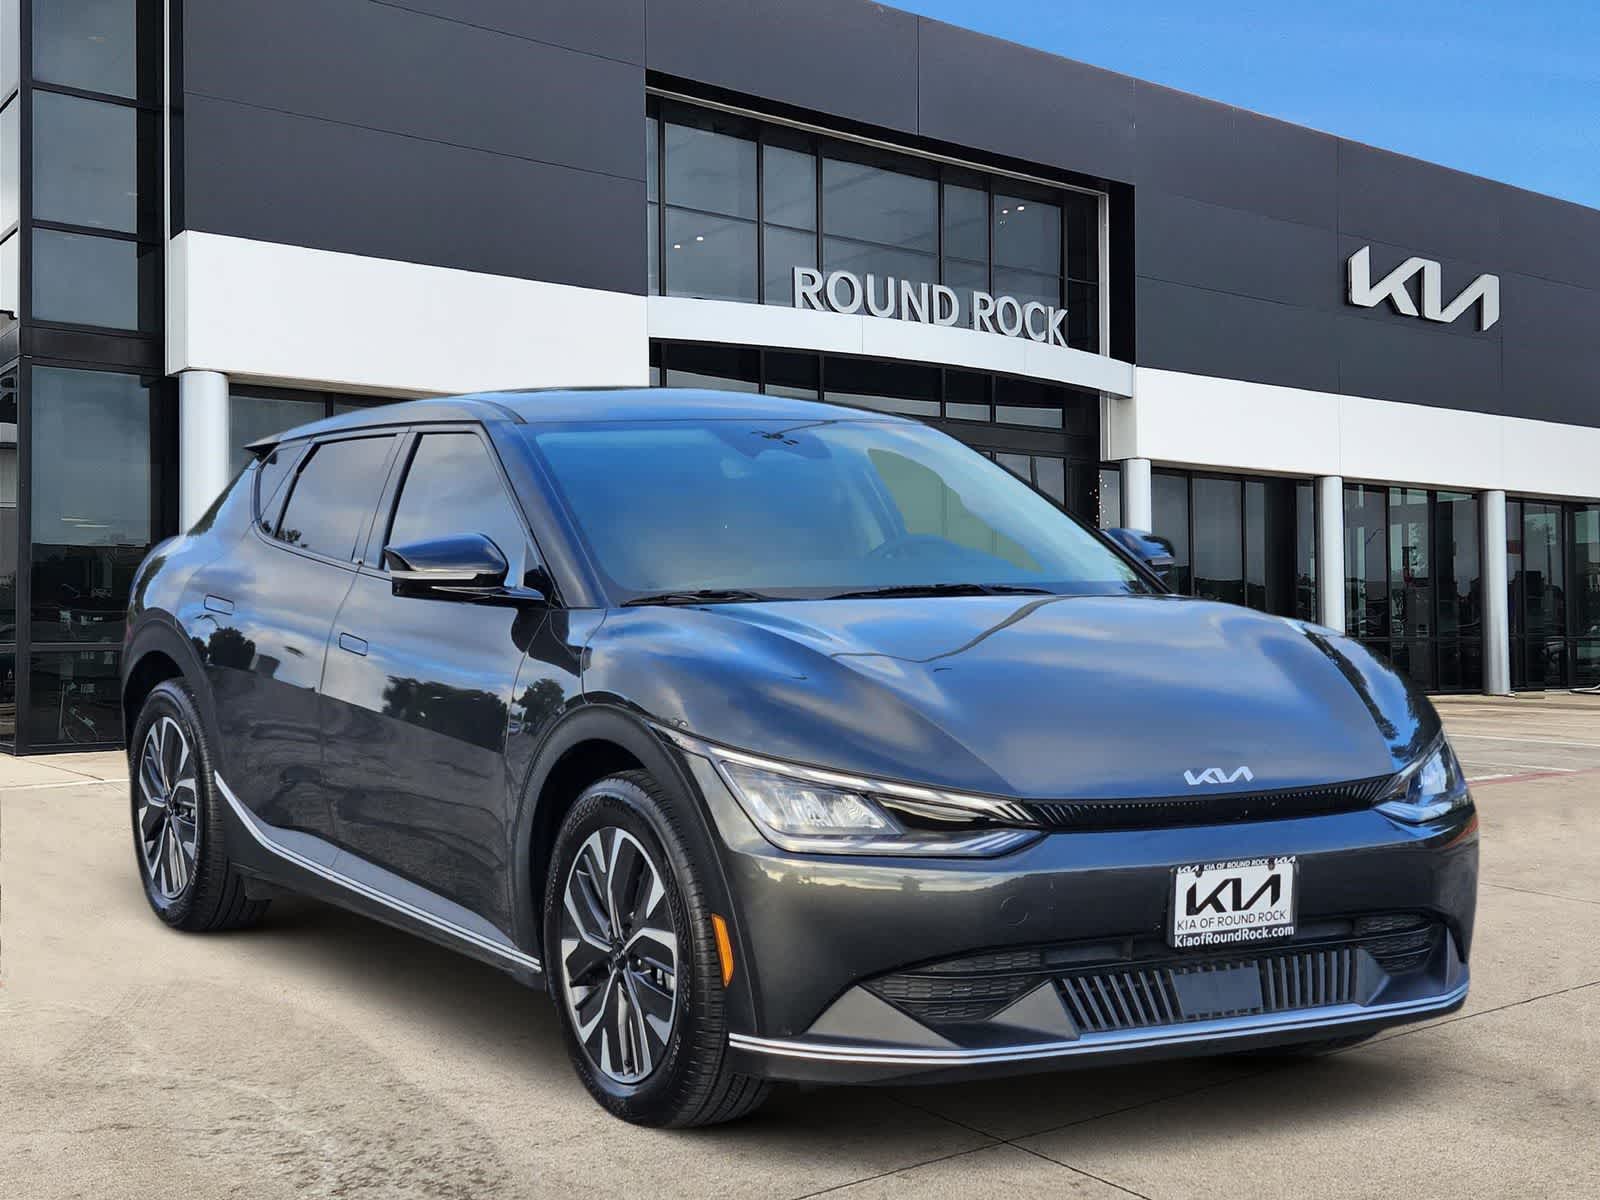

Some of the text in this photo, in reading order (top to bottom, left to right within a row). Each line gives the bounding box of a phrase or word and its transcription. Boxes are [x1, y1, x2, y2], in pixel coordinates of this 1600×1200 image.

[1348, 245, 1499, 331] KIA
[793, 265, 1069, 348] ROUND ROCK
[1183, 766, 1254, 786] KIA
[1204, 863, 1216, 871] KIA
[1216, 862, 1226, 870] OF
[1227, 860, 1250, 868] ROUND
[1251, 858, 1269, 866] ROCK
[1186, 874, 1280, 916] KIA
[1177, 910, 1286, 930] KIA OF ROUND ROCK
[1174, 926, 1294, 947] KiaofRoundRock.com
